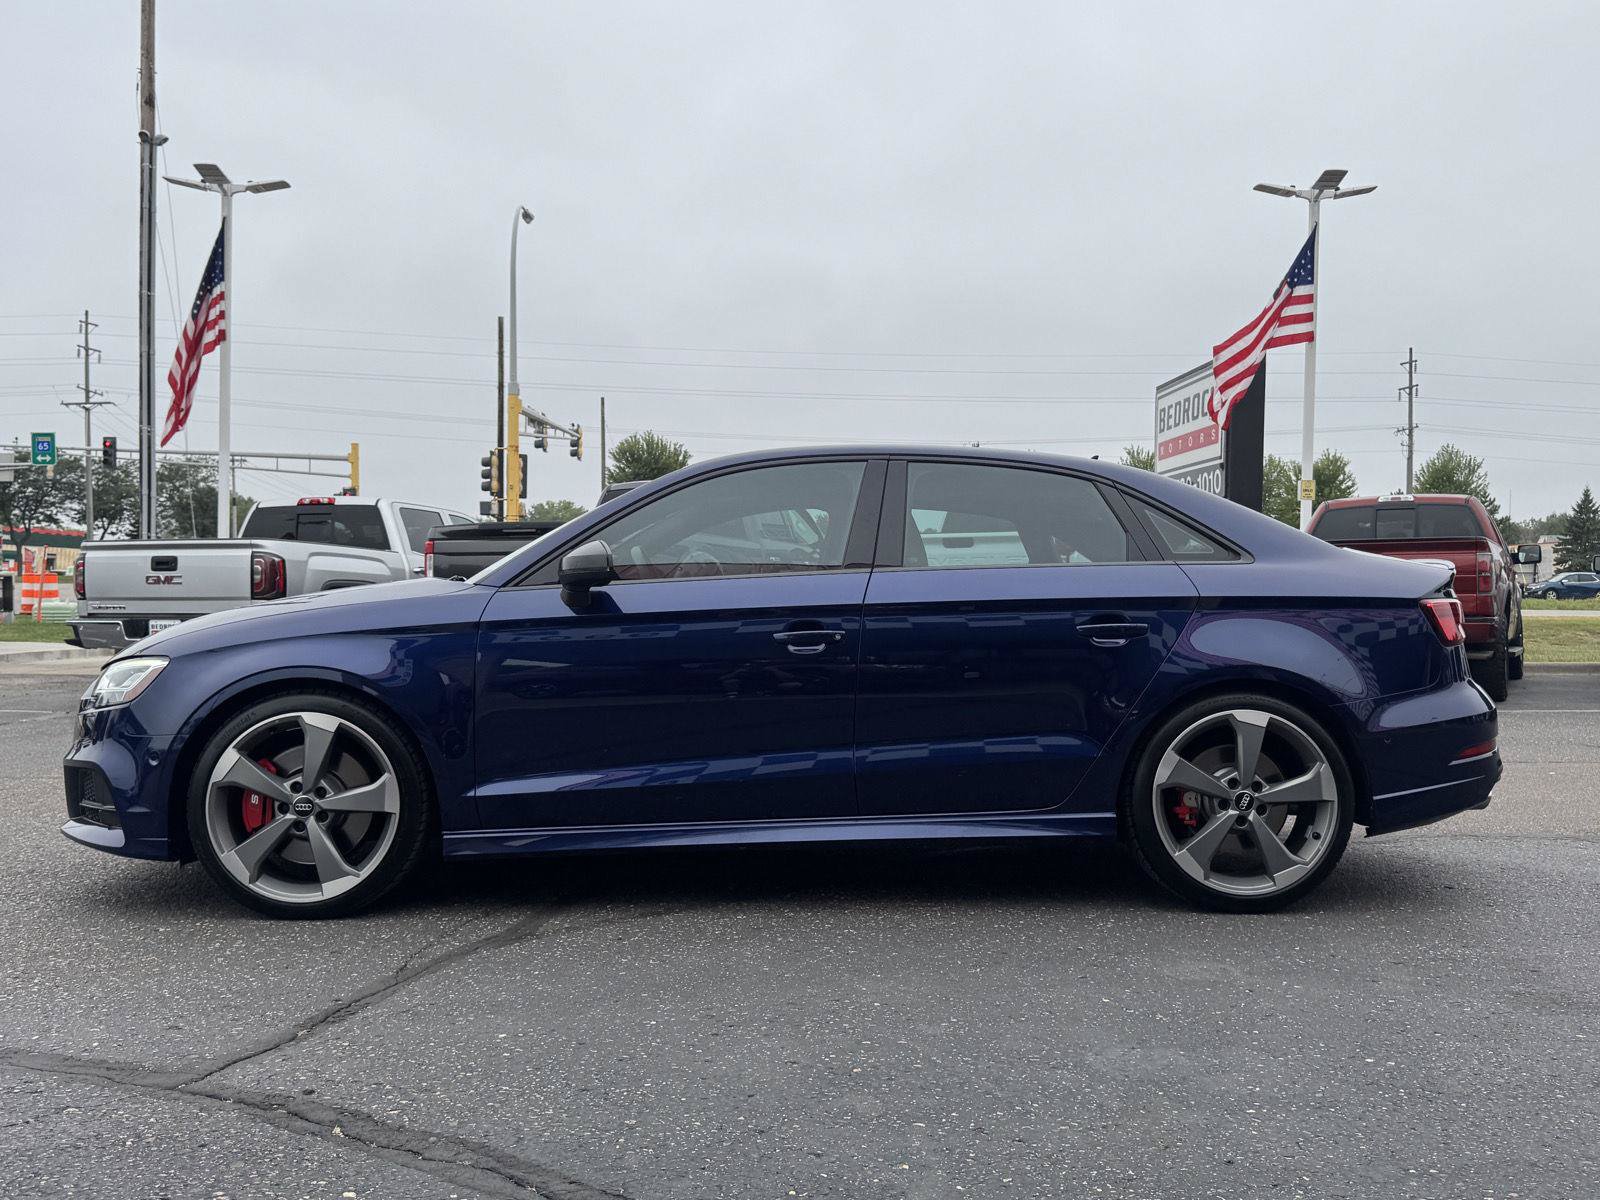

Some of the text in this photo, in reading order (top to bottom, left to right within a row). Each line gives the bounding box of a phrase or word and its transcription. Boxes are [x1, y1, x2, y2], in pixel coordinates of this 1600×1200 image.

[1158, 387, 1214, 434] BEDROC
[38, 442, 49, 450] 65
[1160, 428, 1217, 456] MOTORS
[145, 575, 183, 585] GMC
